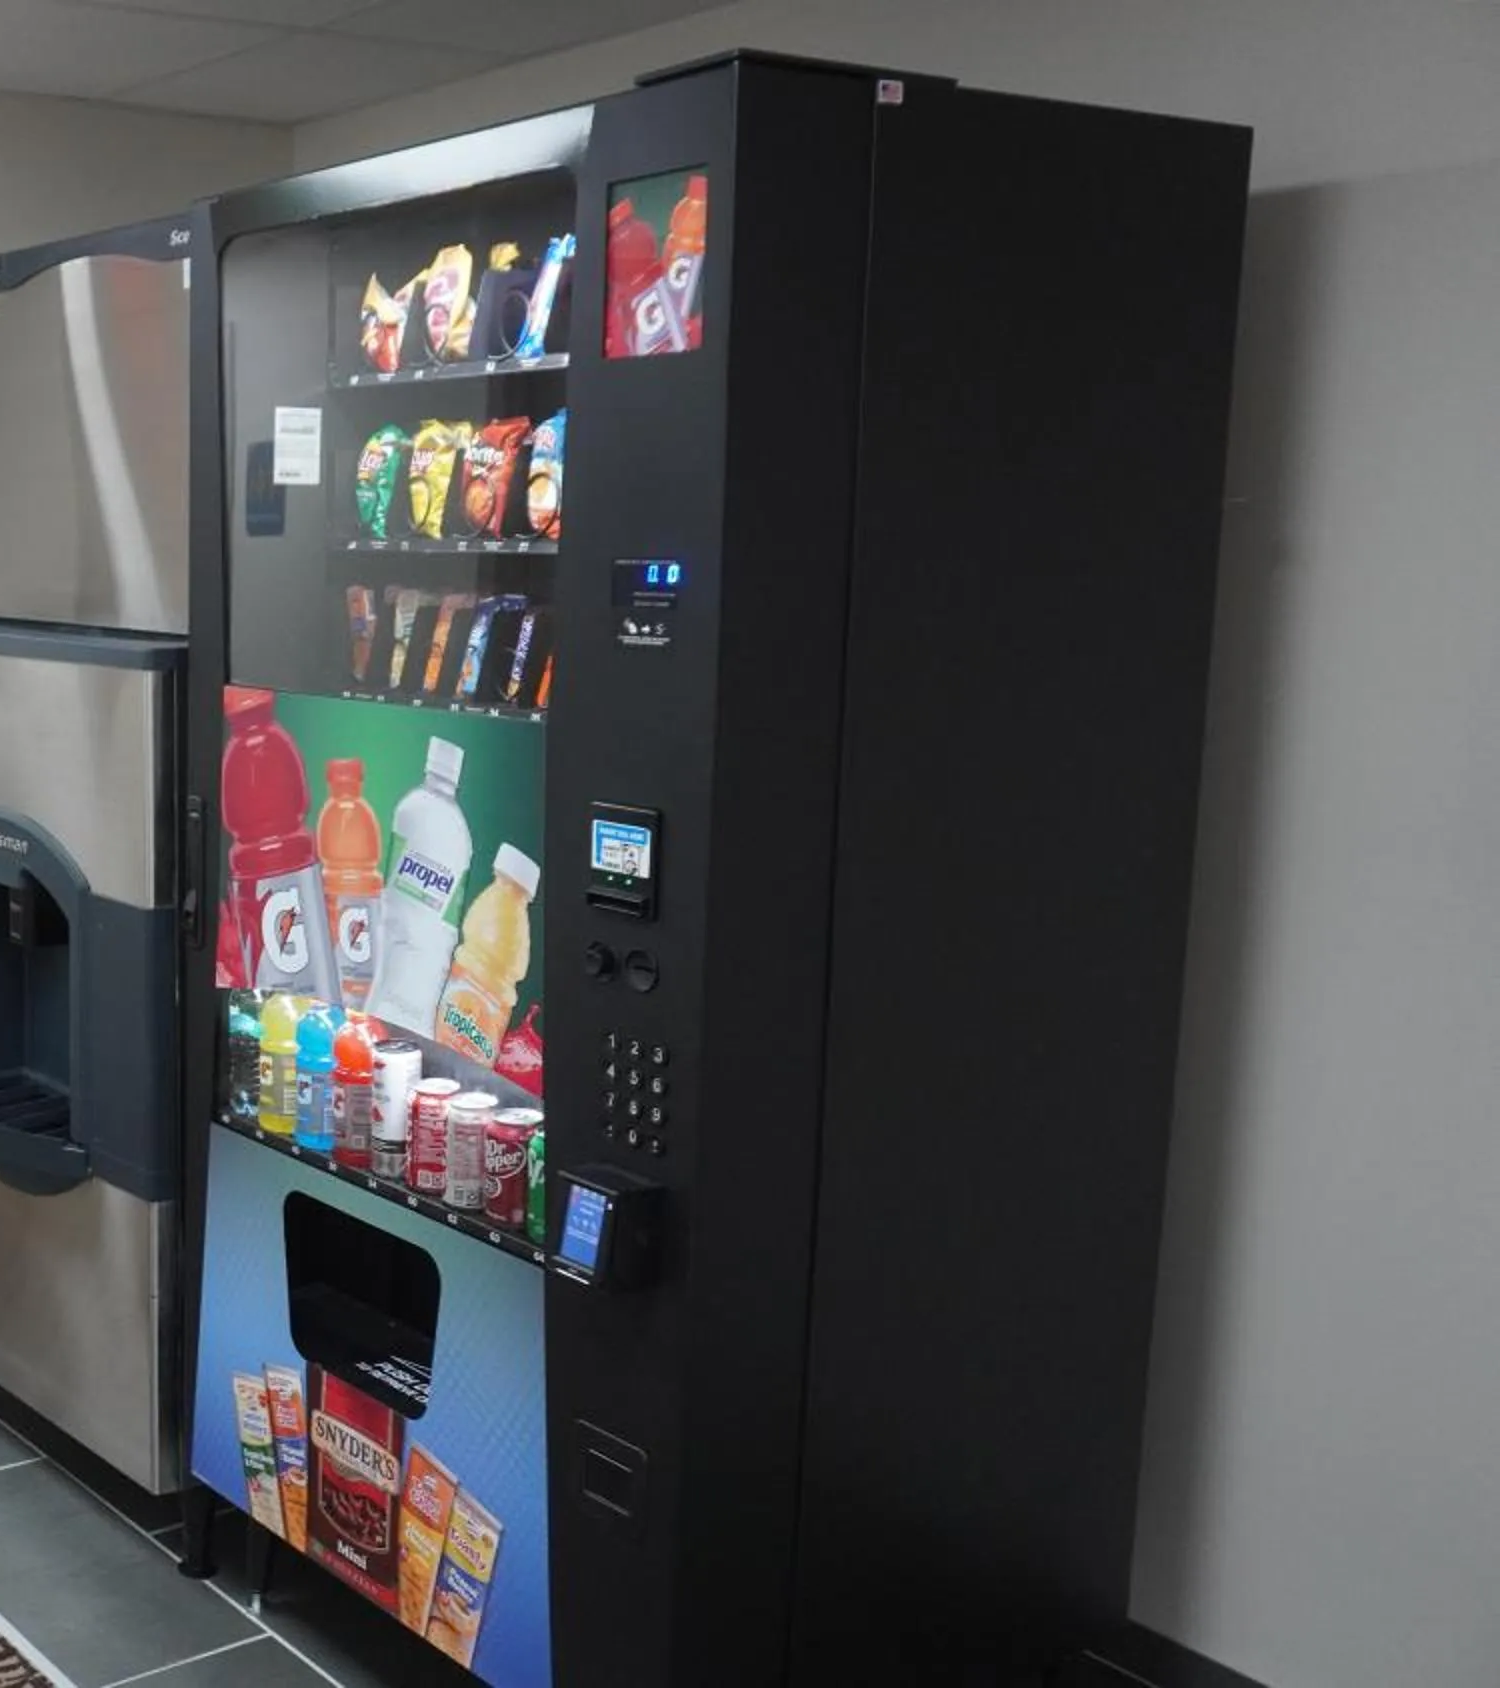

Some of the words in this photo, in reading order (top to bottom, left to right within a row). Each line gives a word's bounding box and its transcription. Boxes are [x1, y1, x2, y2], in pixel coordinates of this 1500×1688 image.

[398, 856, 454, 895] propel
[262, 887, 309, 974] G
[339, 907, 371, 963] G
[631, 1041, 639, 1055] 2
[653, 1047, 663, 1063] 3
[606, 1063, 615, 1078] 4
[652, 1107, 661, 1122] 9
[486, 1139, 506, 1155] Dr
[629, 1129, 637, 1144] 0
[315, 1415, 395, 1481] SNYDER'S
[337, 1539, 367, 1571] Mini
